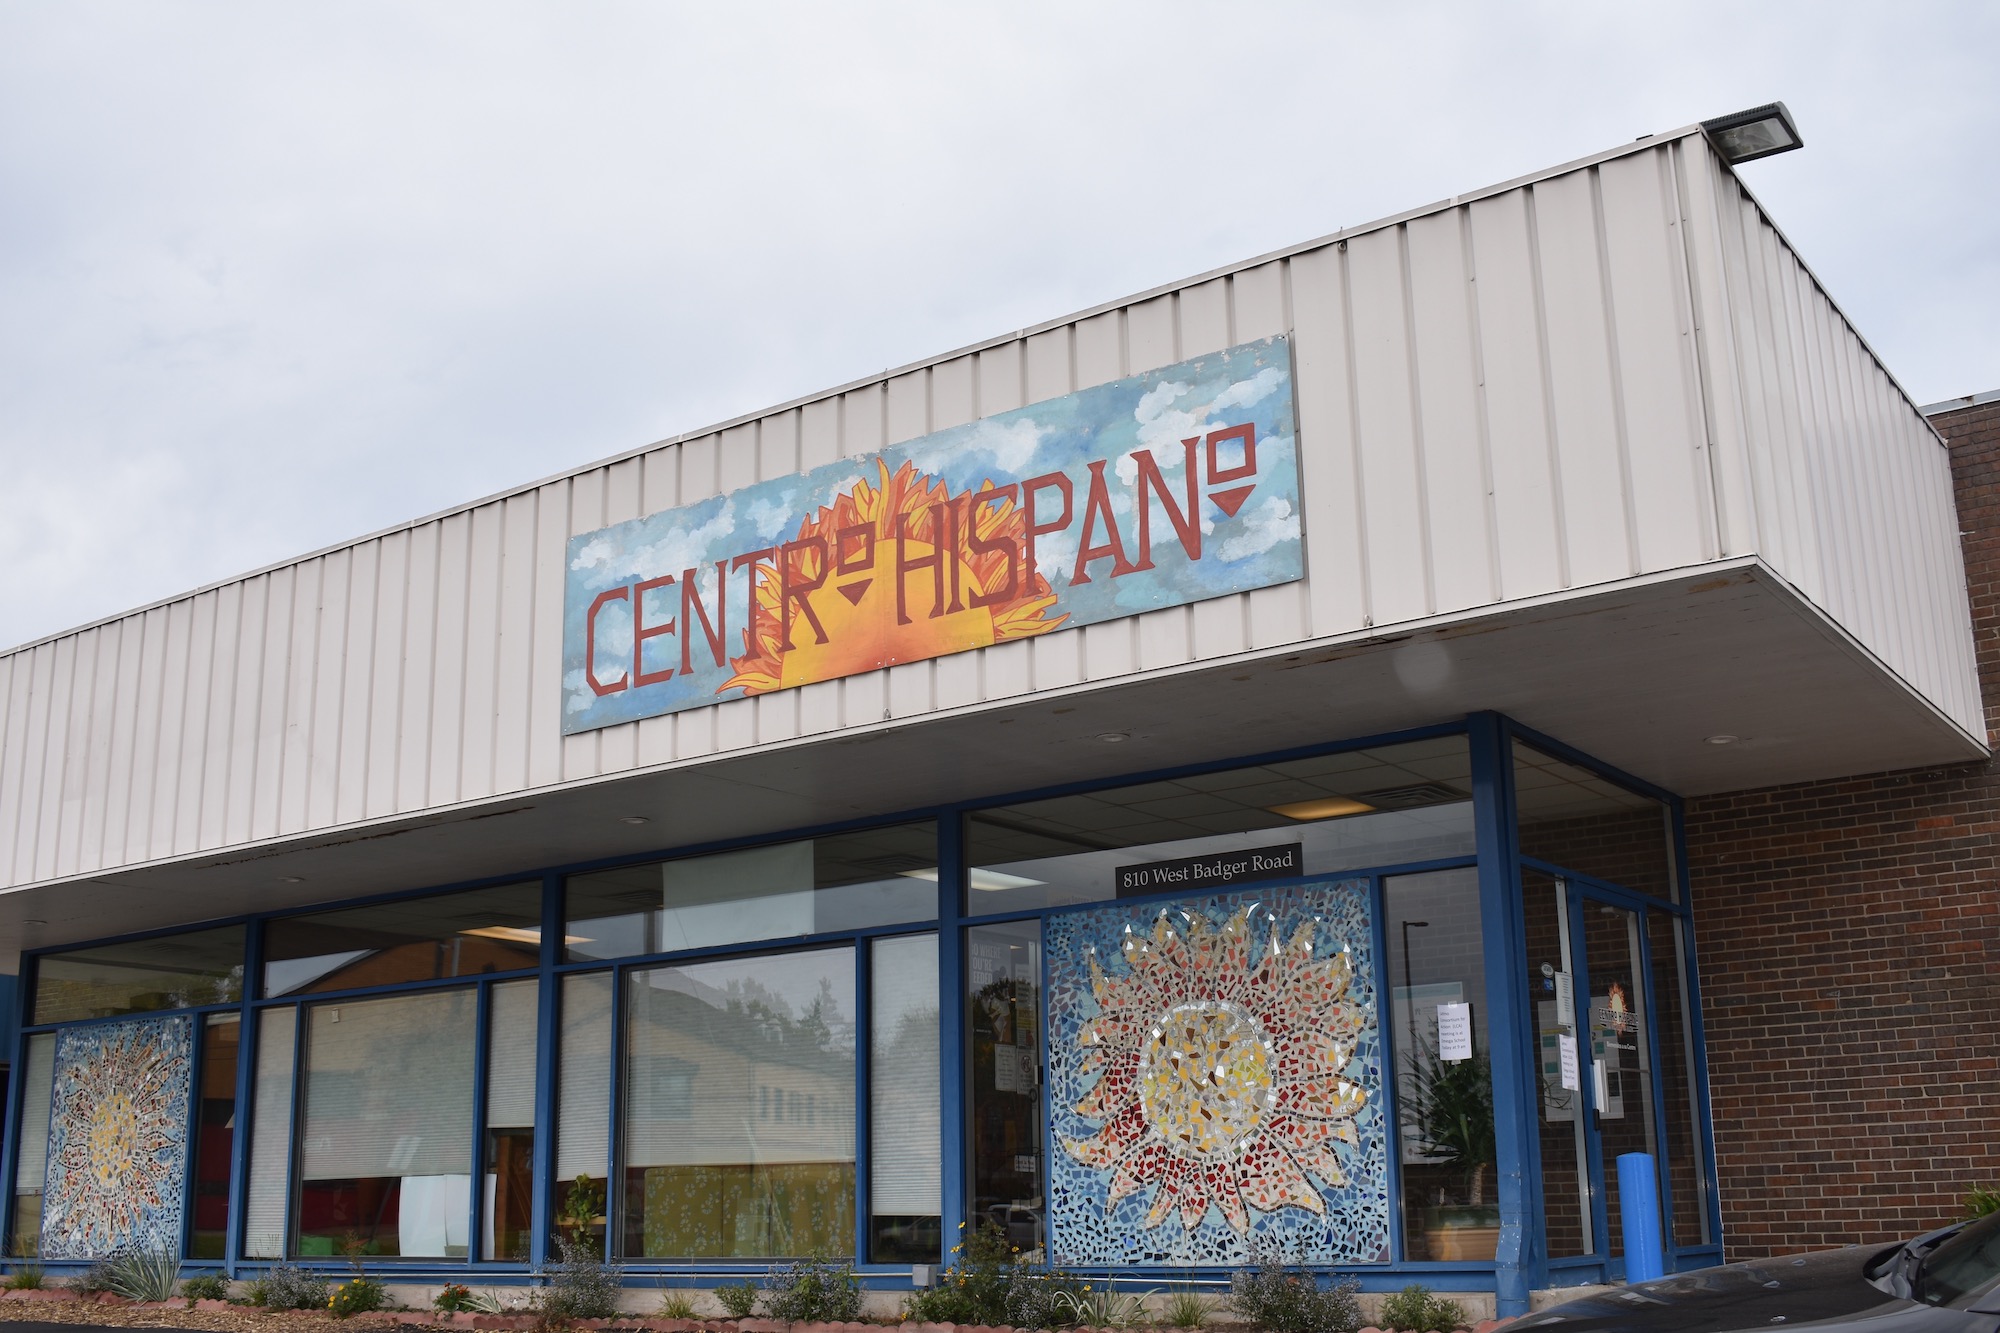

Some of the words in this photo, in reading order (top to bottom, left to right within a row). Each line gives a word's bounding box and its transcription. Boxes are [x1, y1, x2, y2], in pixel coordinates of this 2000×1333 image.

[585, 522, 876, 698] CENTRO
[894, 421, 1257, 627] HISPANO
[1123, 870, 1149, 888] 810
[1153, 867, 1189, 883] West
[1193, 860, 1248, 881] Badger
[1252, 851, 1293, 872] Road
[980, 943, 1001, 959] WHERE
[972, 957, 993, 972] OU'RE
[973, 971, 993, 984] EEDED
